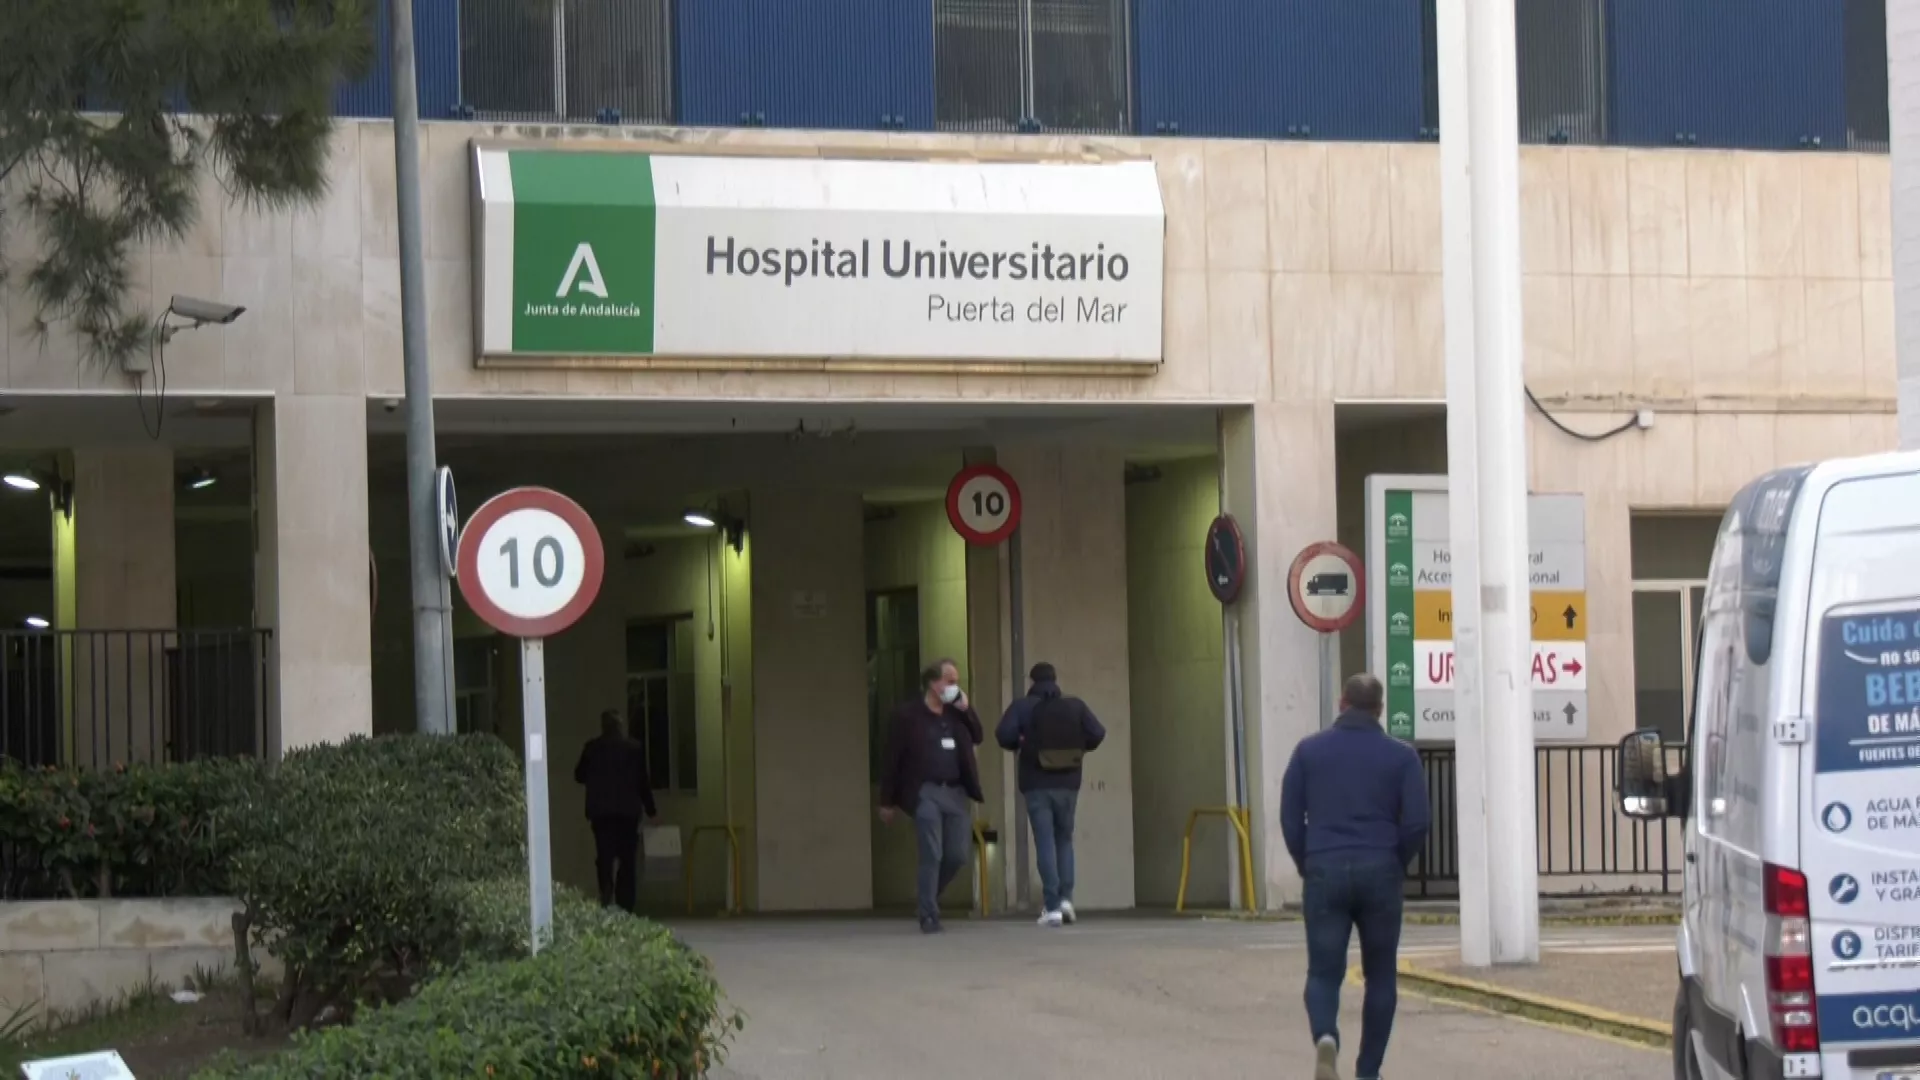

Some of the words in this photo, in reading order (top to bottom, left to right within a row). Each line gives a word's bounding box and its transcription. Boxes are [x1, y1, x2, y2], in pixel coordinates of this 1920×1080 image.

[707, 236, 869, 287] Hospital
[883, 240, 1129, 282] Universitario
[524, 302, 559, 317] Junta
[562, 302, 577, 317] de
[580, 302, 640, 317] Andalucía
[928, 294, 1014, 322] Puerta
[1027, 295, 1064, 323] del
[1077, 296, 1128, 323] Mar
[972, 491, 1004, 516] 10
[499, 534, 564, 589] 10
[1842, 617, 1906, 645] Cuida
[1880, 651, 1900, 667] no
[1868, 714, 1890, 734] DE
[1859, 747, 1905, 762] FUENTES
[1866, 797, 1911, 813] AGUA
[1867, 815, 1888, 831] DE
[1871, 868, 1918, 886] INSTA
[1875, 887, 1886, 902] Y
[1852, 1003, 1920, 1032] acqu
